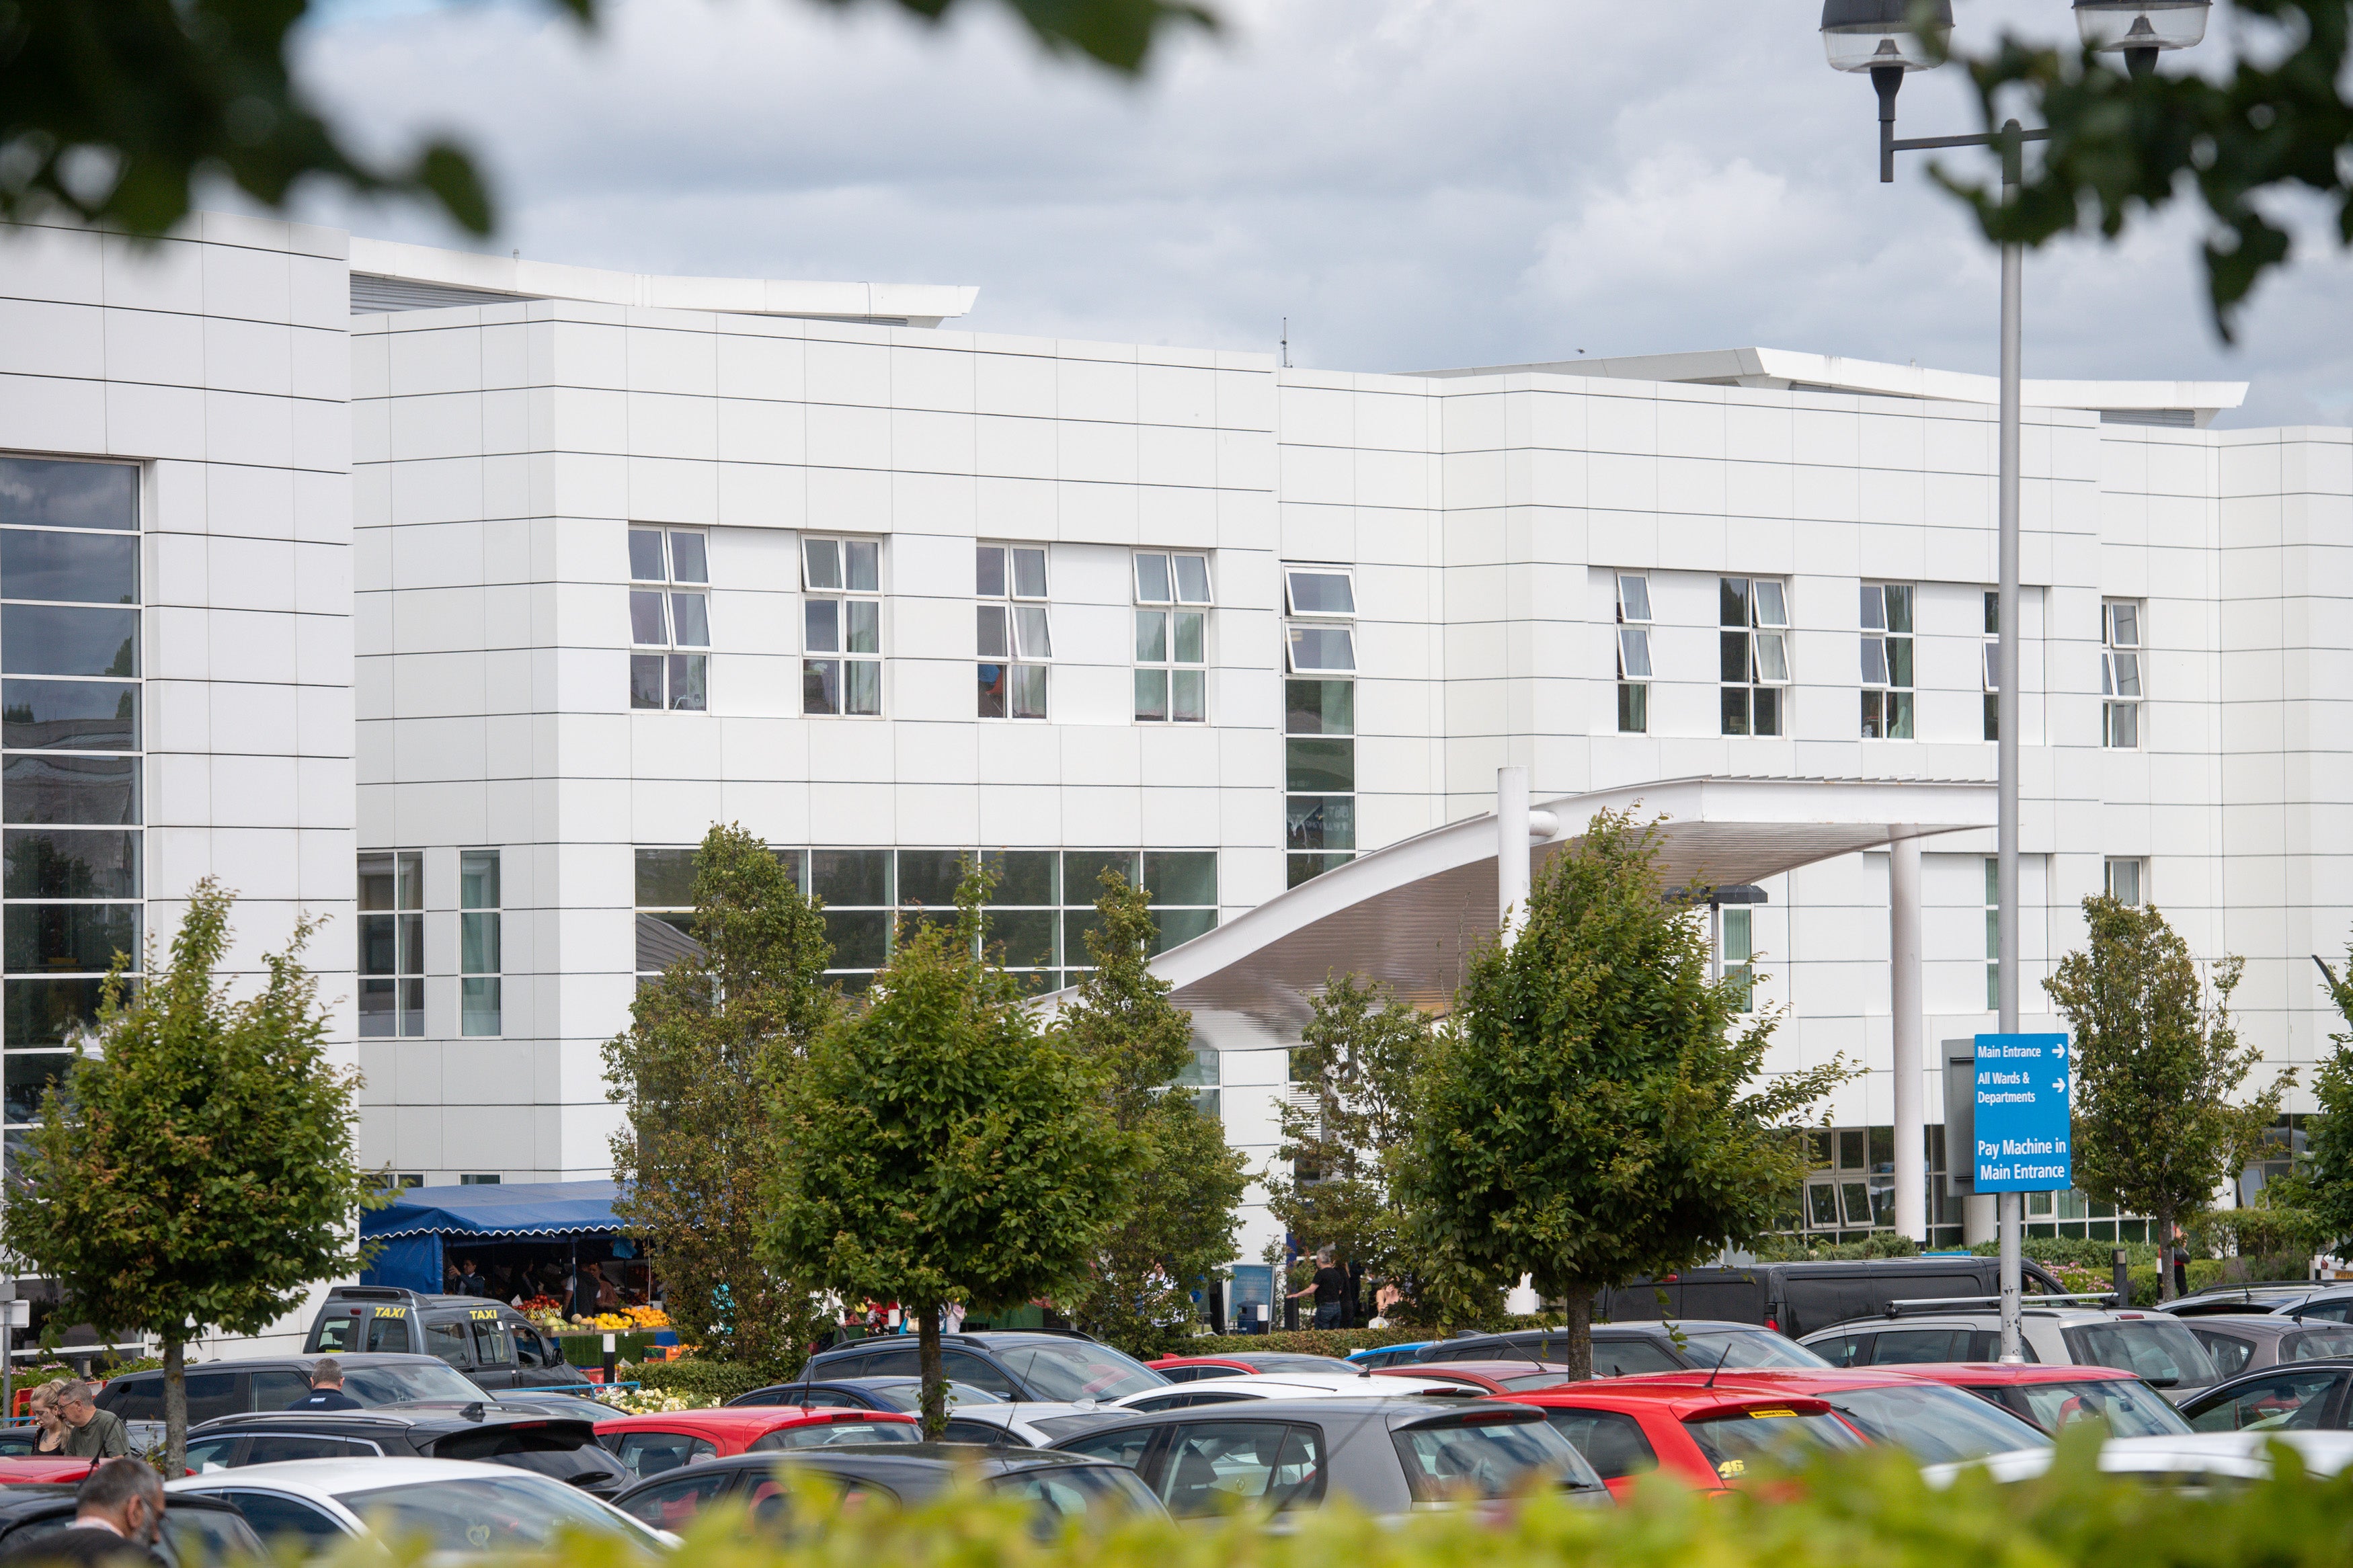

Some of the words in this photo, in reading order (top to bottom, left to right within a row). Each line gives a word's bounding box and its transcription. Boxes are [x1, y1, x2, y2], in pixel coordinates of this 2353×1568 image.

[1978, 1046, 2000, 1057] Main
[2003, 1046, 2041, 1057] Entrance
[1978, 1072, 1990, 1084] All
[1993, 1071, 2020, 1083] Wards
[2023, 1072, 2029, 1083] &
[1978, 1091, 2035, 1106] Departments
[1979, 1141, 1999, 1159] Pay
[2003, 1139, 2052, 1155] Machine
[2056, 1138, 2066, 1153] in
[1981, 1164, 2010, 1180] Main
[2014, 1164, 2065, 1179] Entrance
[376, 1307, 405, 1317] TAXI
[469, 1311, 497, 1319] TAXI
[1718, 1459, 1745, 1473] 46
